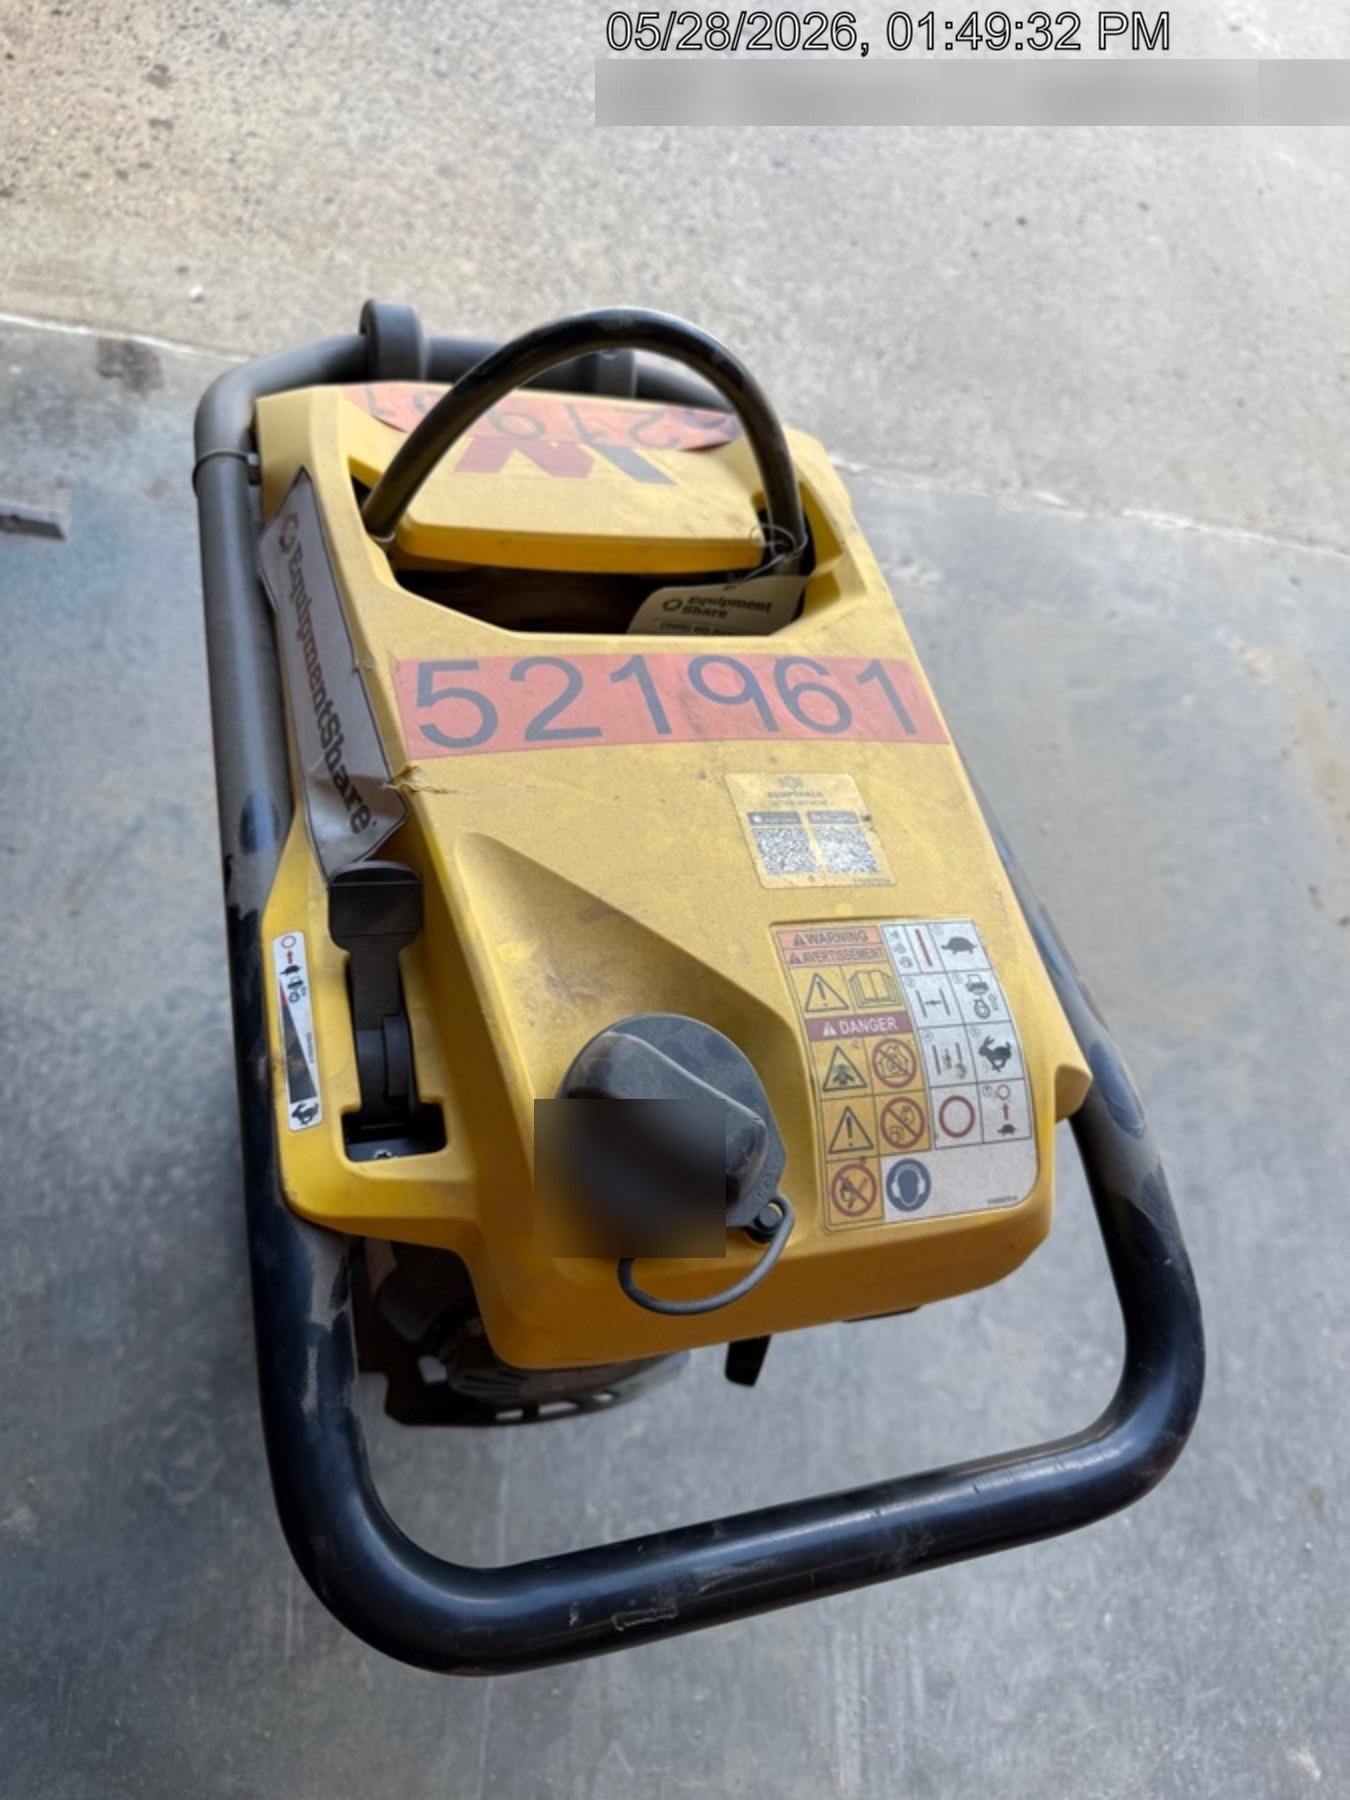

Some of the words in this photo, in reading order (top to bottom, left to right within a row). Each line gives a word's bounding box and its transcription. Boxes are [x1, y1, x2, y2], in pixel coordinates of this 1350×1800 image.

[681, 606, 729, 619] Share
[687, 596, 773, 614] Equipment
[414, 654, 918, 749] 521961
[805, 929, 869, 945] WARNING
[838, 1016, 899, 1034] DANGER
